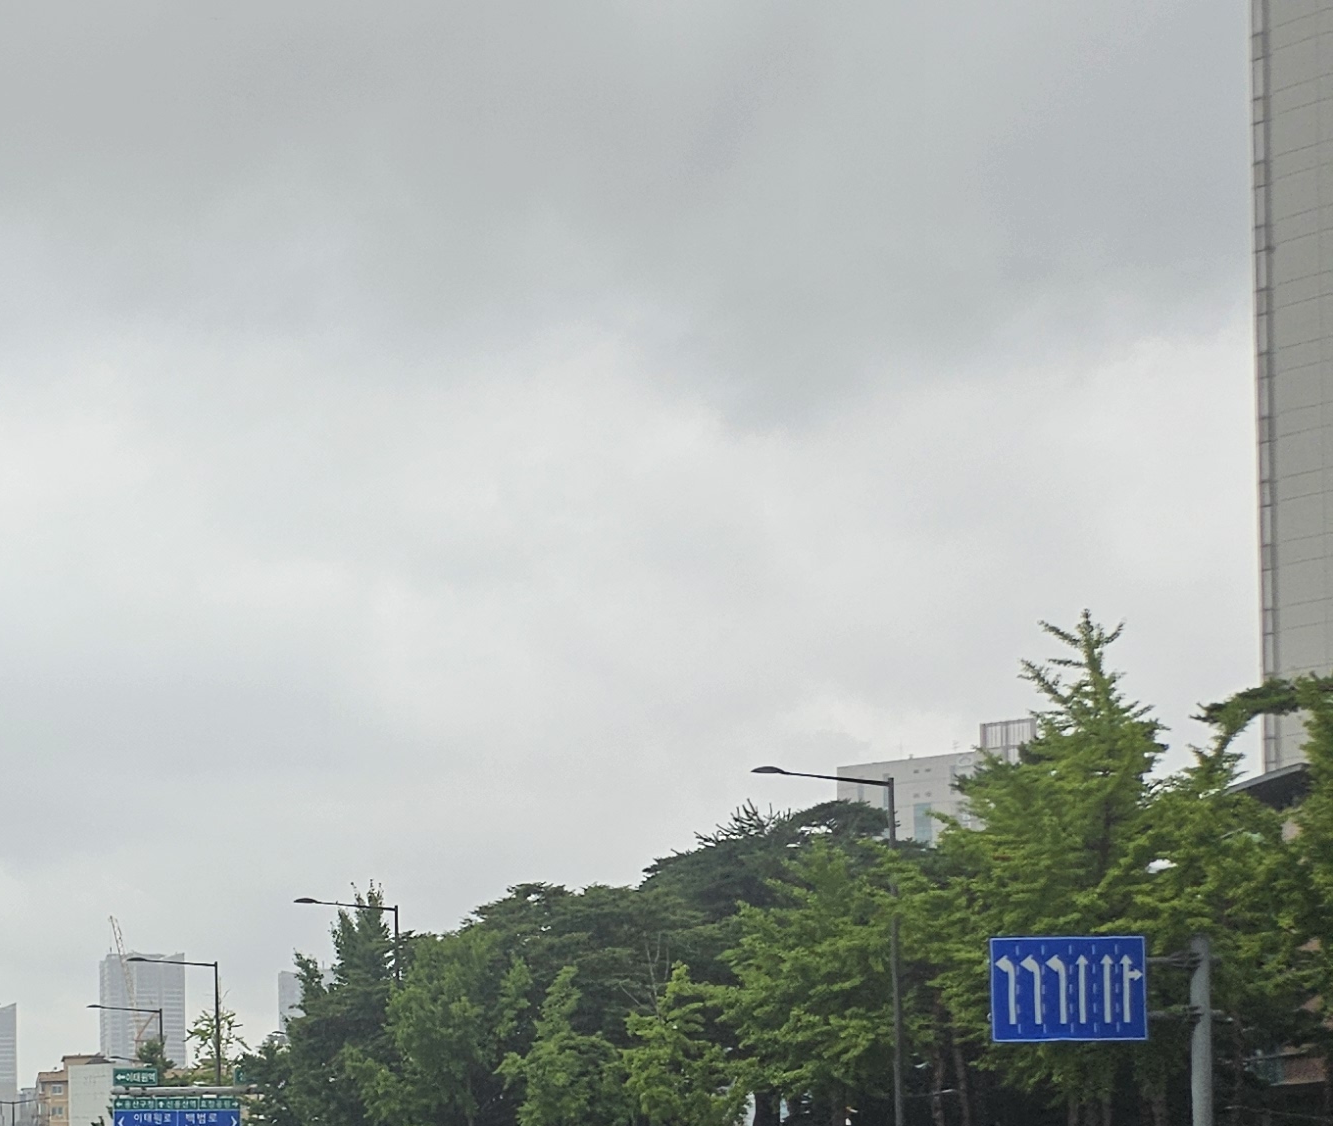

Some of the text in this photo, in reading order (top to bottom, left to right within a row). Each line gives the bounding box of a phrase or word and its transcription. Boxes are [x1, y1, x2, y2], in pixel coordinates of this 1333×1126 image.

[126, 1072, 156, 1083] 이태원역
[133, 1113, 217, 1124] 이태원로 백범로
